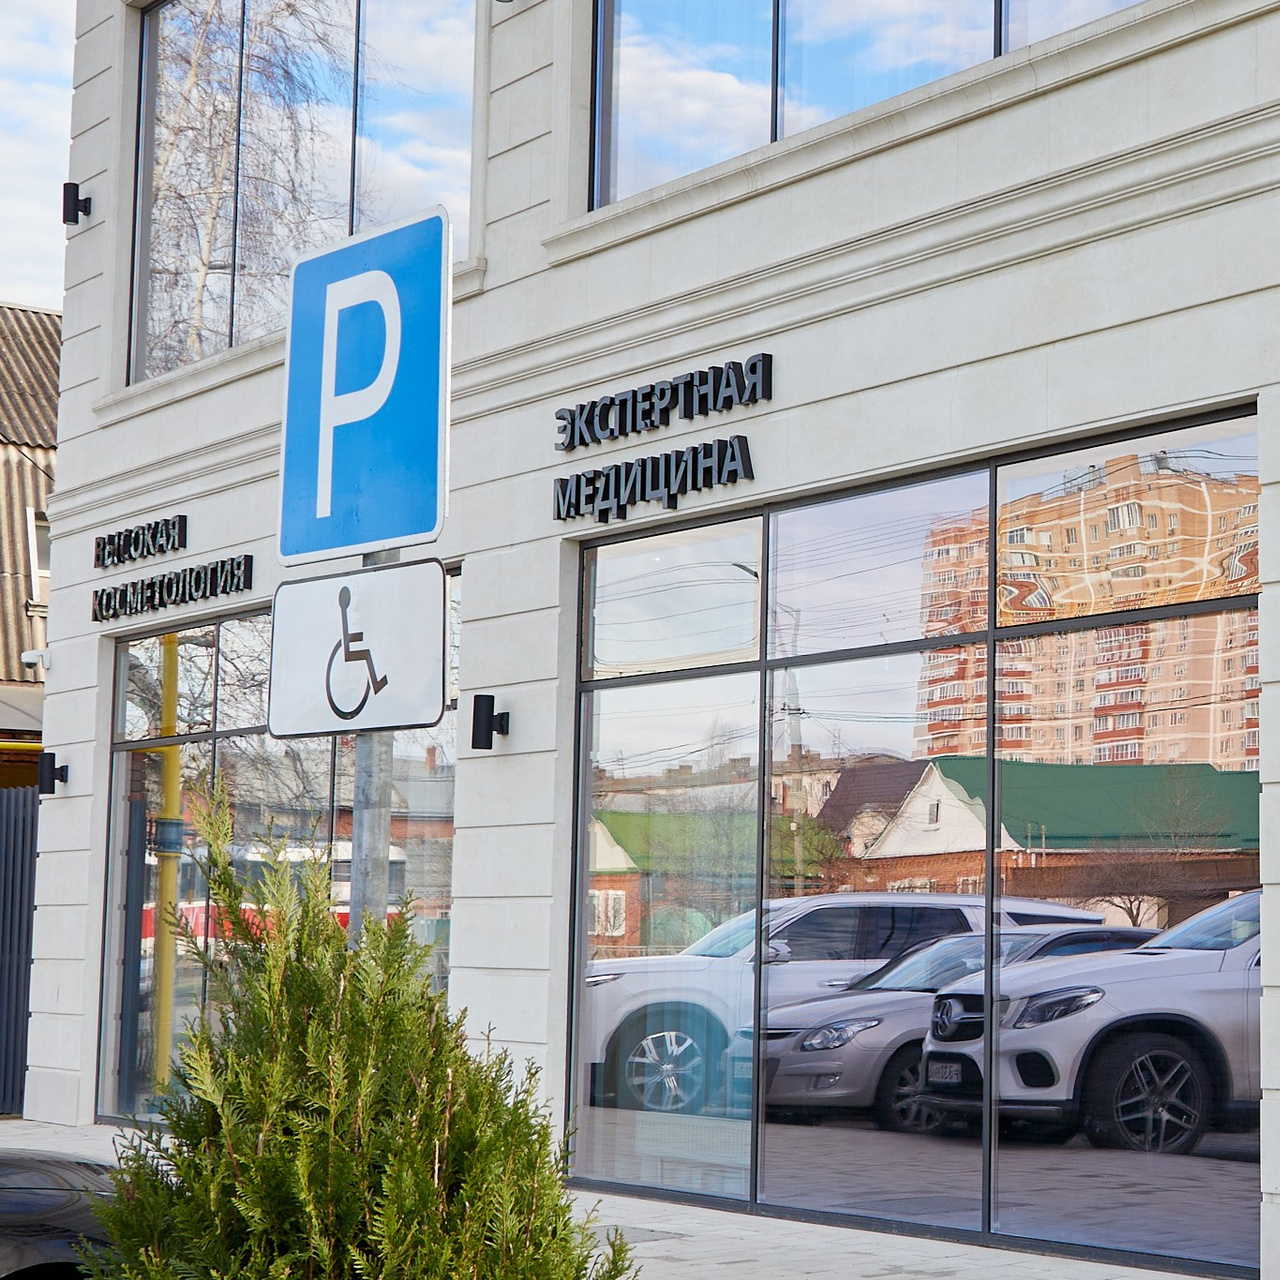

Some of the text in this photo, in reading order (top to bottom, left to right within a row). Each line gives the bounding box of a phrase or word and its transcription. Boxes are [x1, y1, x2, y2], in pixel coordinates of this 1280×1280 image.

[316, 270, 402, 519] P
[554, 352, 773, 451] ЭКСПЕРТНАЯ
[553, 434, 755, 523] МЕДИЦИНА
[94, 515, 187, 569] ВЫСОКАЯ
[91, 554, 254, 622] КОСМЕТОЛОГИЯ
